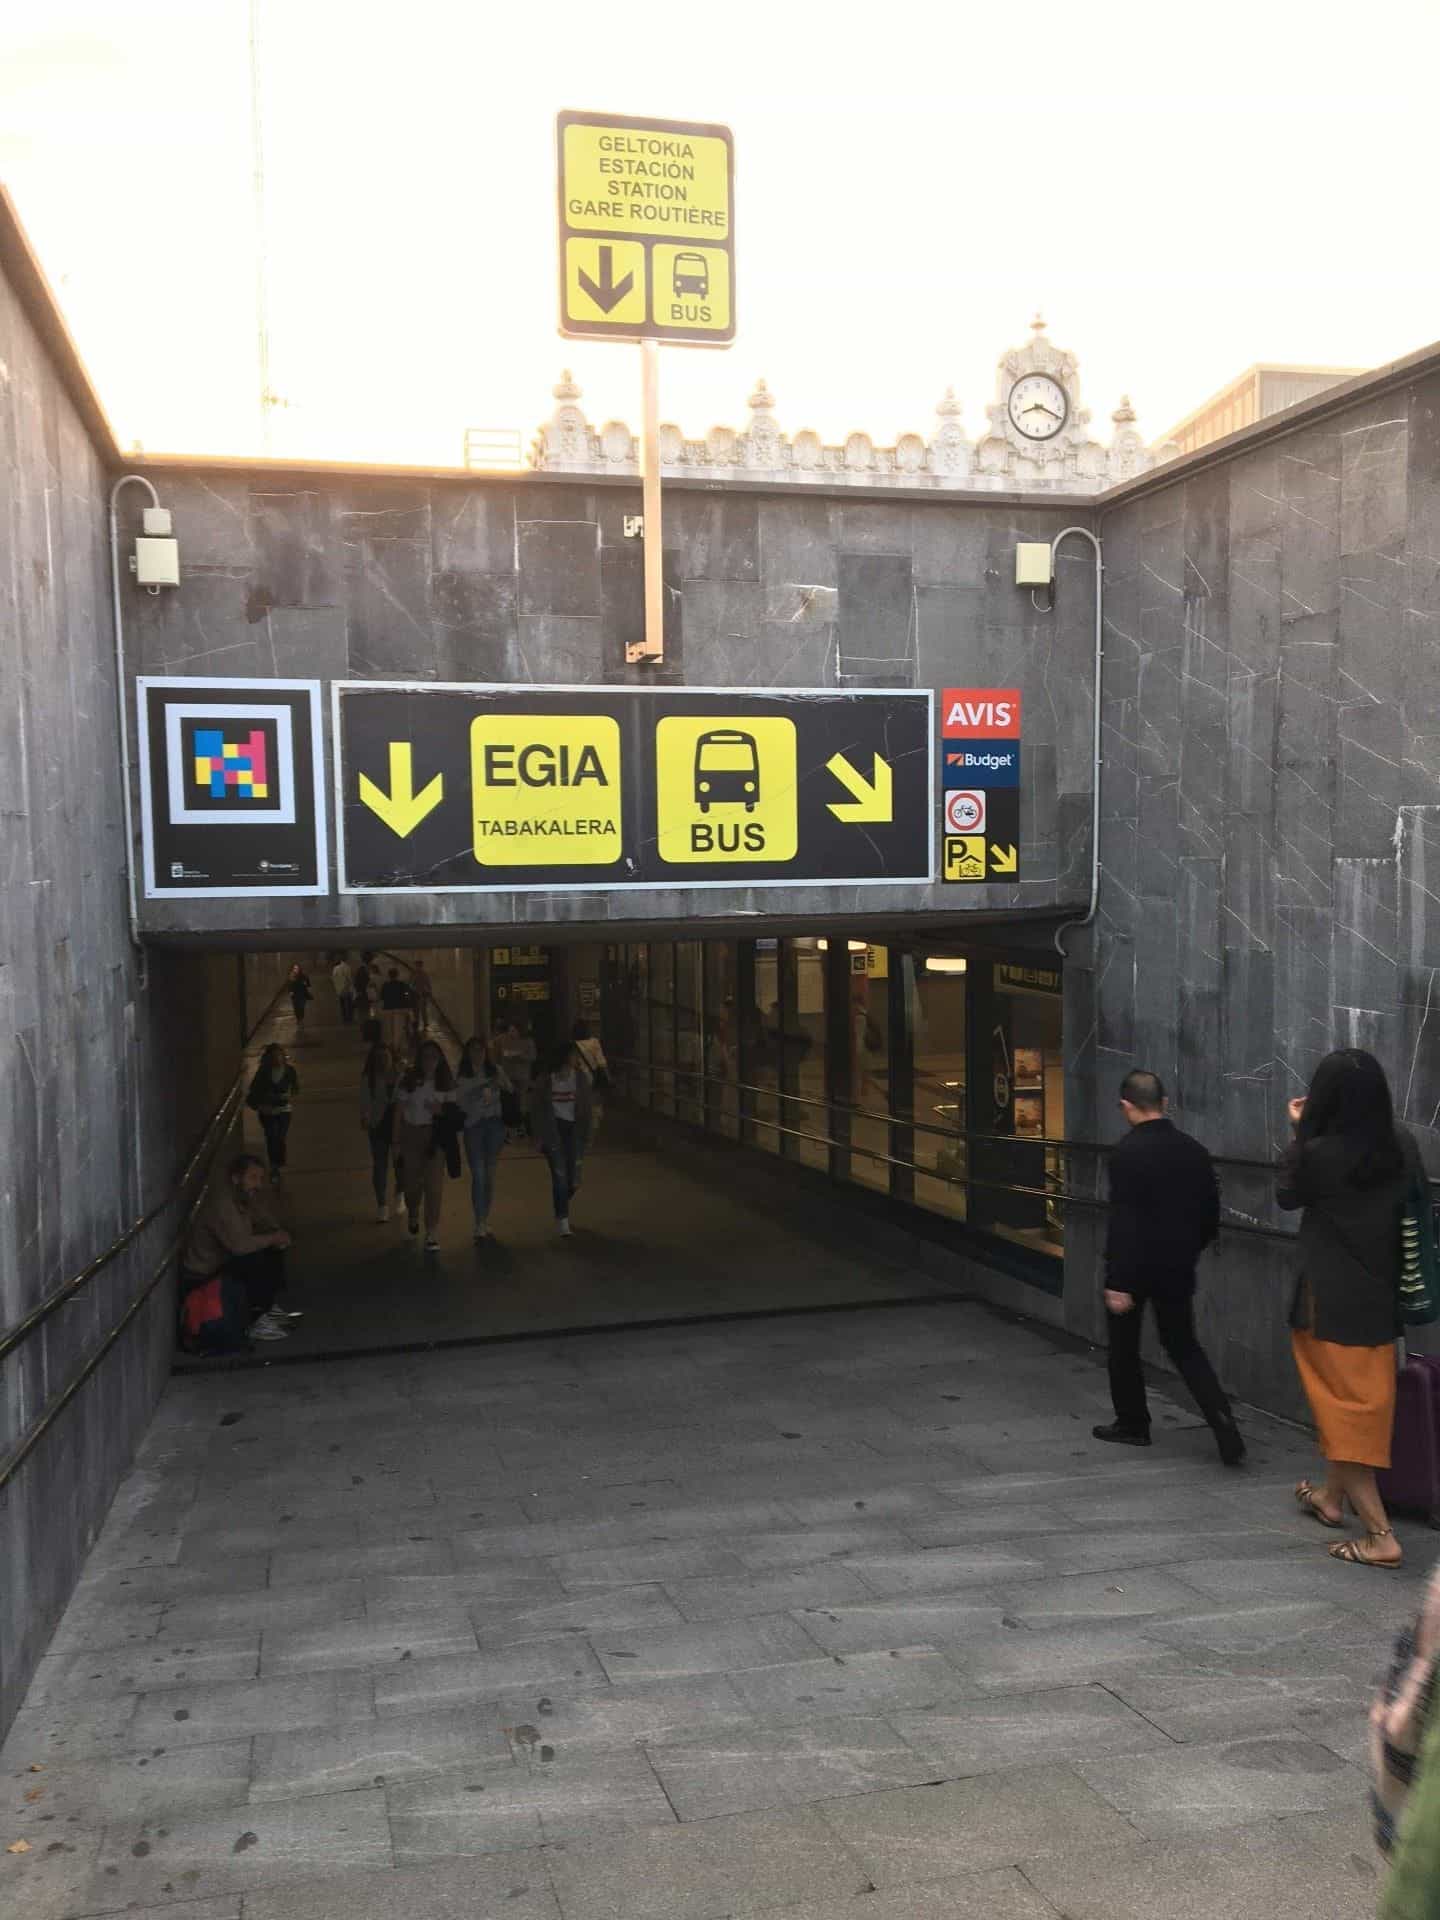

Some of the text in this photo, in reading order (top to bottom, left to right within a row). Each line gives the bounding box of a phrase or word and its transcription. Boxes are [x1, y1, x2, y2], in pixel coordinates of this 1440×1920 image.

[599, 135, 694, 159] GELTOKIA
[599, 157, 695, 181] ESTACIÓN
[607, 180, 687, 201] STATION
[568, 199, 726, 226] GARE ROUTIÈRE
[671, 303, 712, 322] BUS
[946, 702, 1011, 726] AVIS
[484, 743, 609, 788] EGIA
[964, 753, 1012, 770] Budget
[479, 818, 616, 837] TABAKALERA
[690, 822, 766, 853] BUS
[947, 839, 968, 868] P
